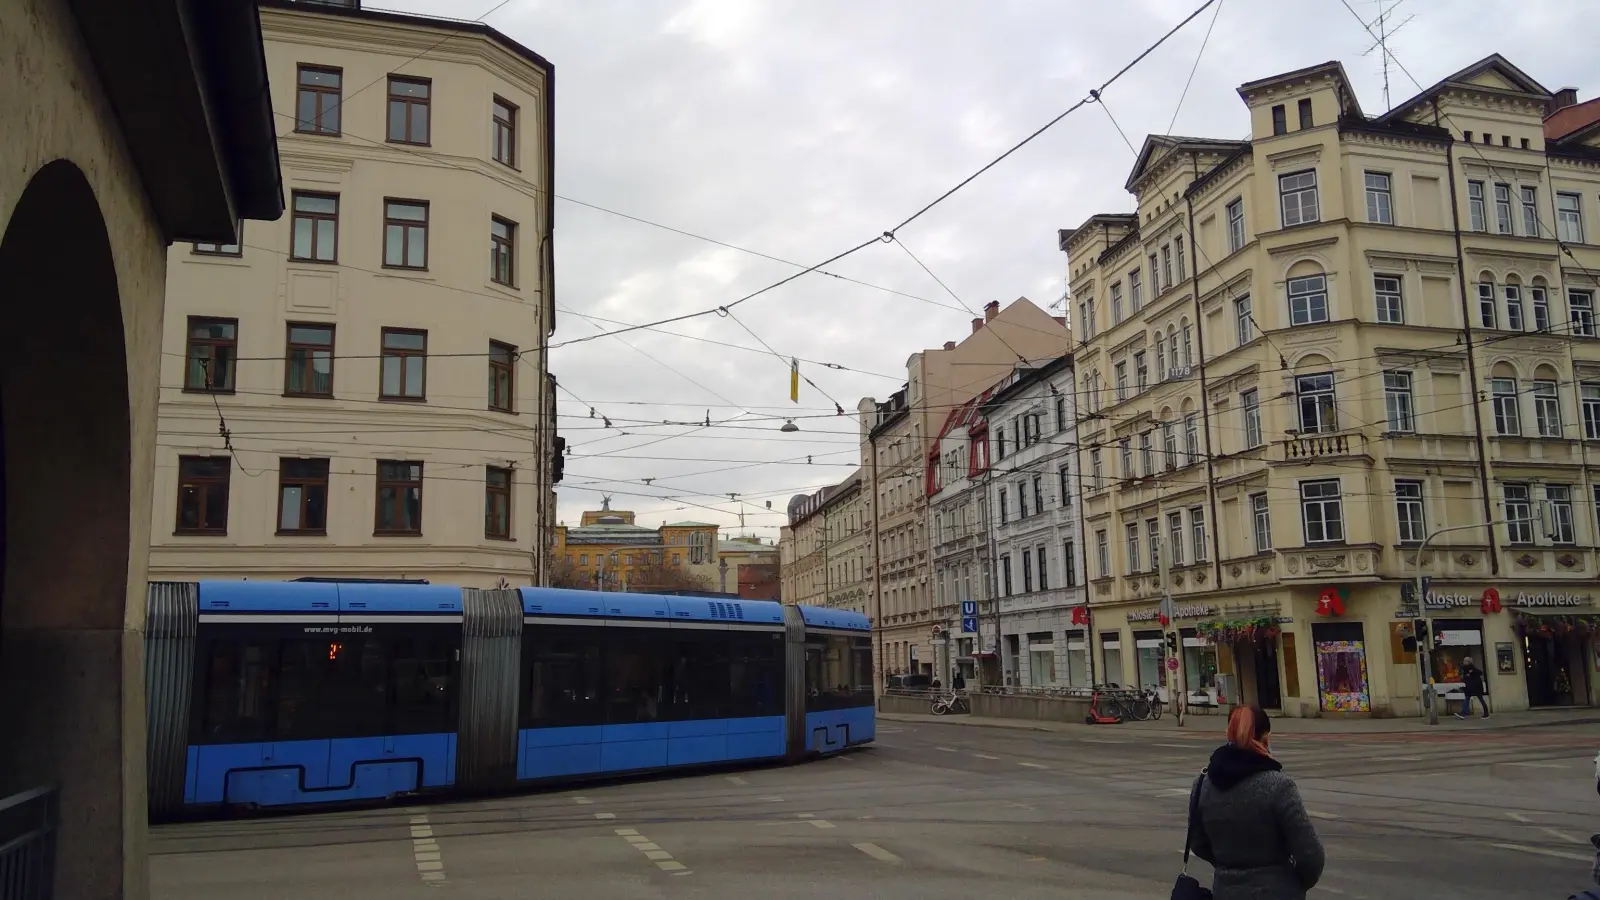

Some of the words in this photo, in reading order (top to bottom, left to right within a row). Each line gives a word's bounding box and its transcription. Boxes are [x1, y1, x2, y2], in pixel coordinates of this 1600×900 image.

[1171, 367, 1191, 377] 1178
[1517, 592, 1580, 607] Apotheke
[964, 602, 973, 613] U
[1174, 604, 1208, 619] Apotheke
[304, 626, 372, 634] www.mvg-mobil.de
